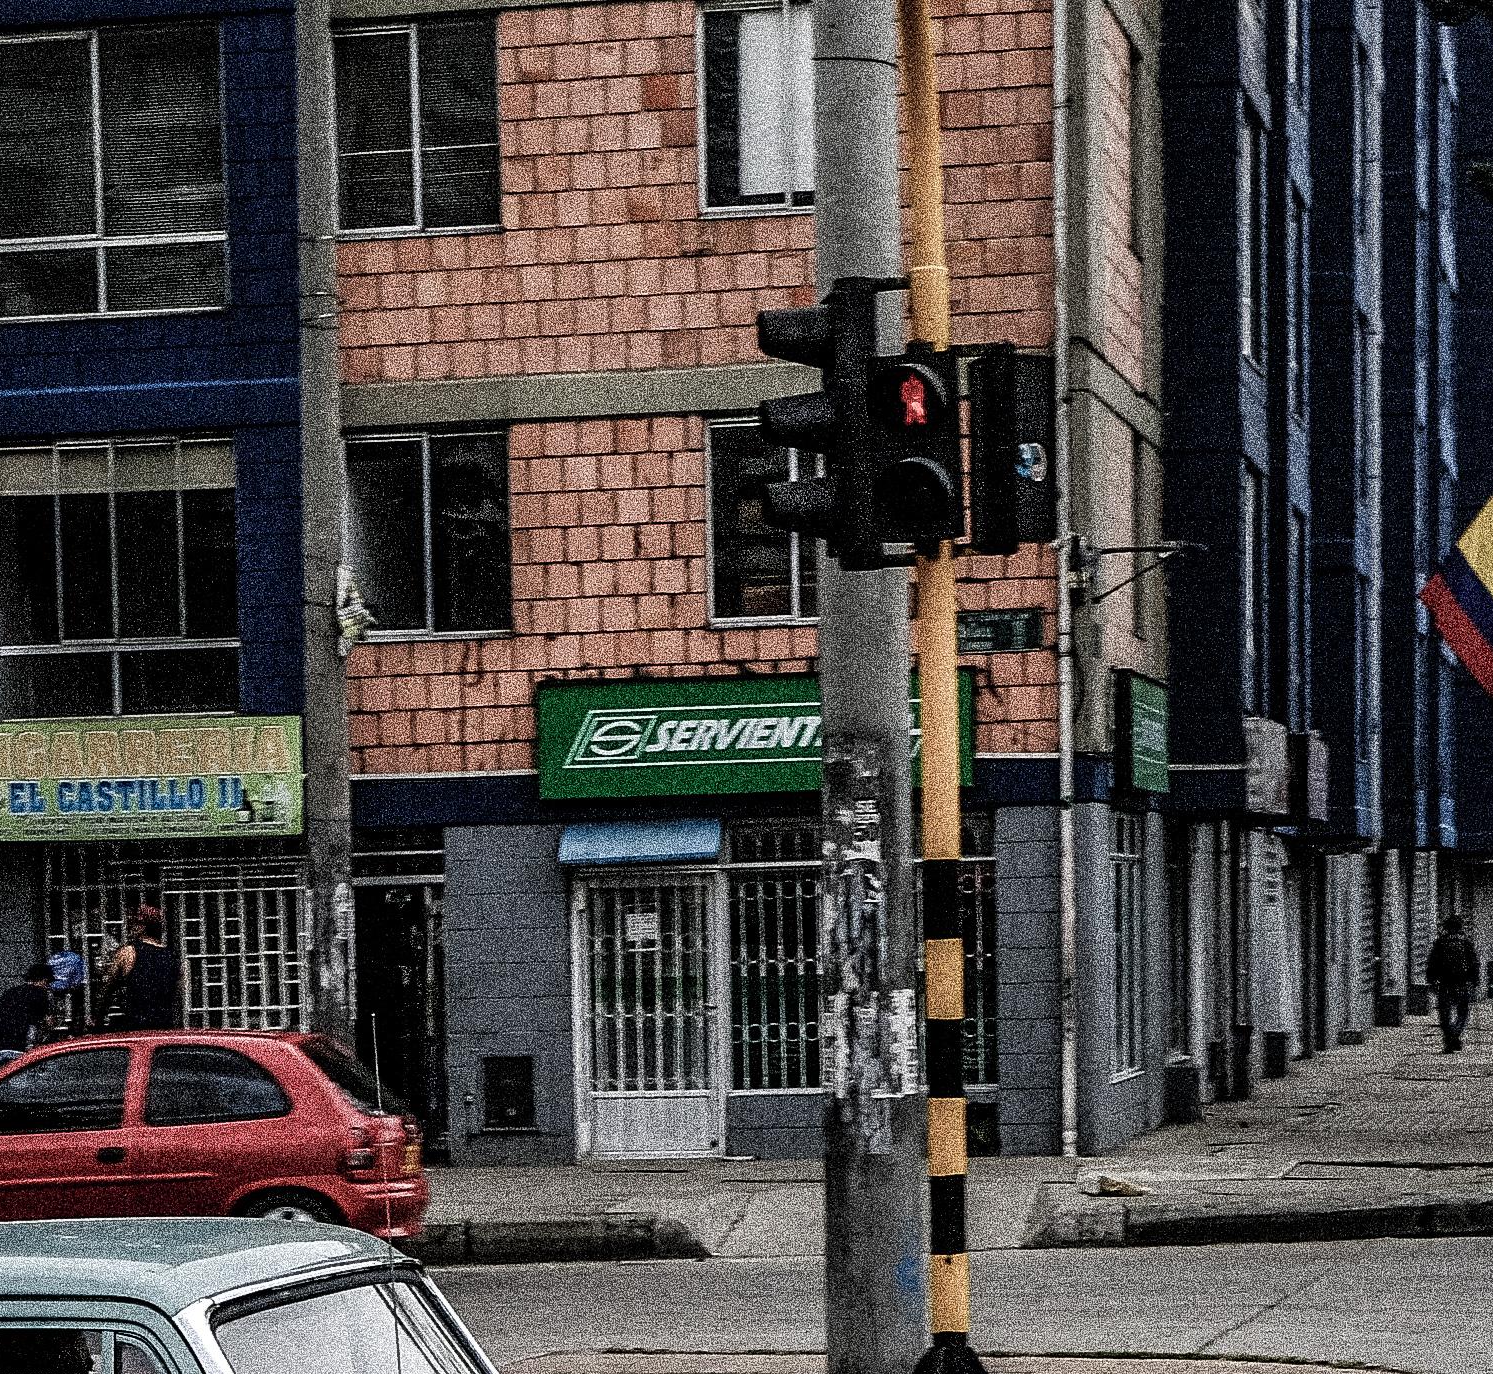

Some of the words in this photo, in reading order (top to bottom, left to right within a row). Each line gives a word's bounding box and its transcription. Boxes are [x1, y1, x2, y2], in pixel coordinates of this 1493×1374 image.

[645, 712, 915, 753] SERVIENT
[8, 781, 45, 814] EL
[58, 777, 204, 814] CASTILLO
